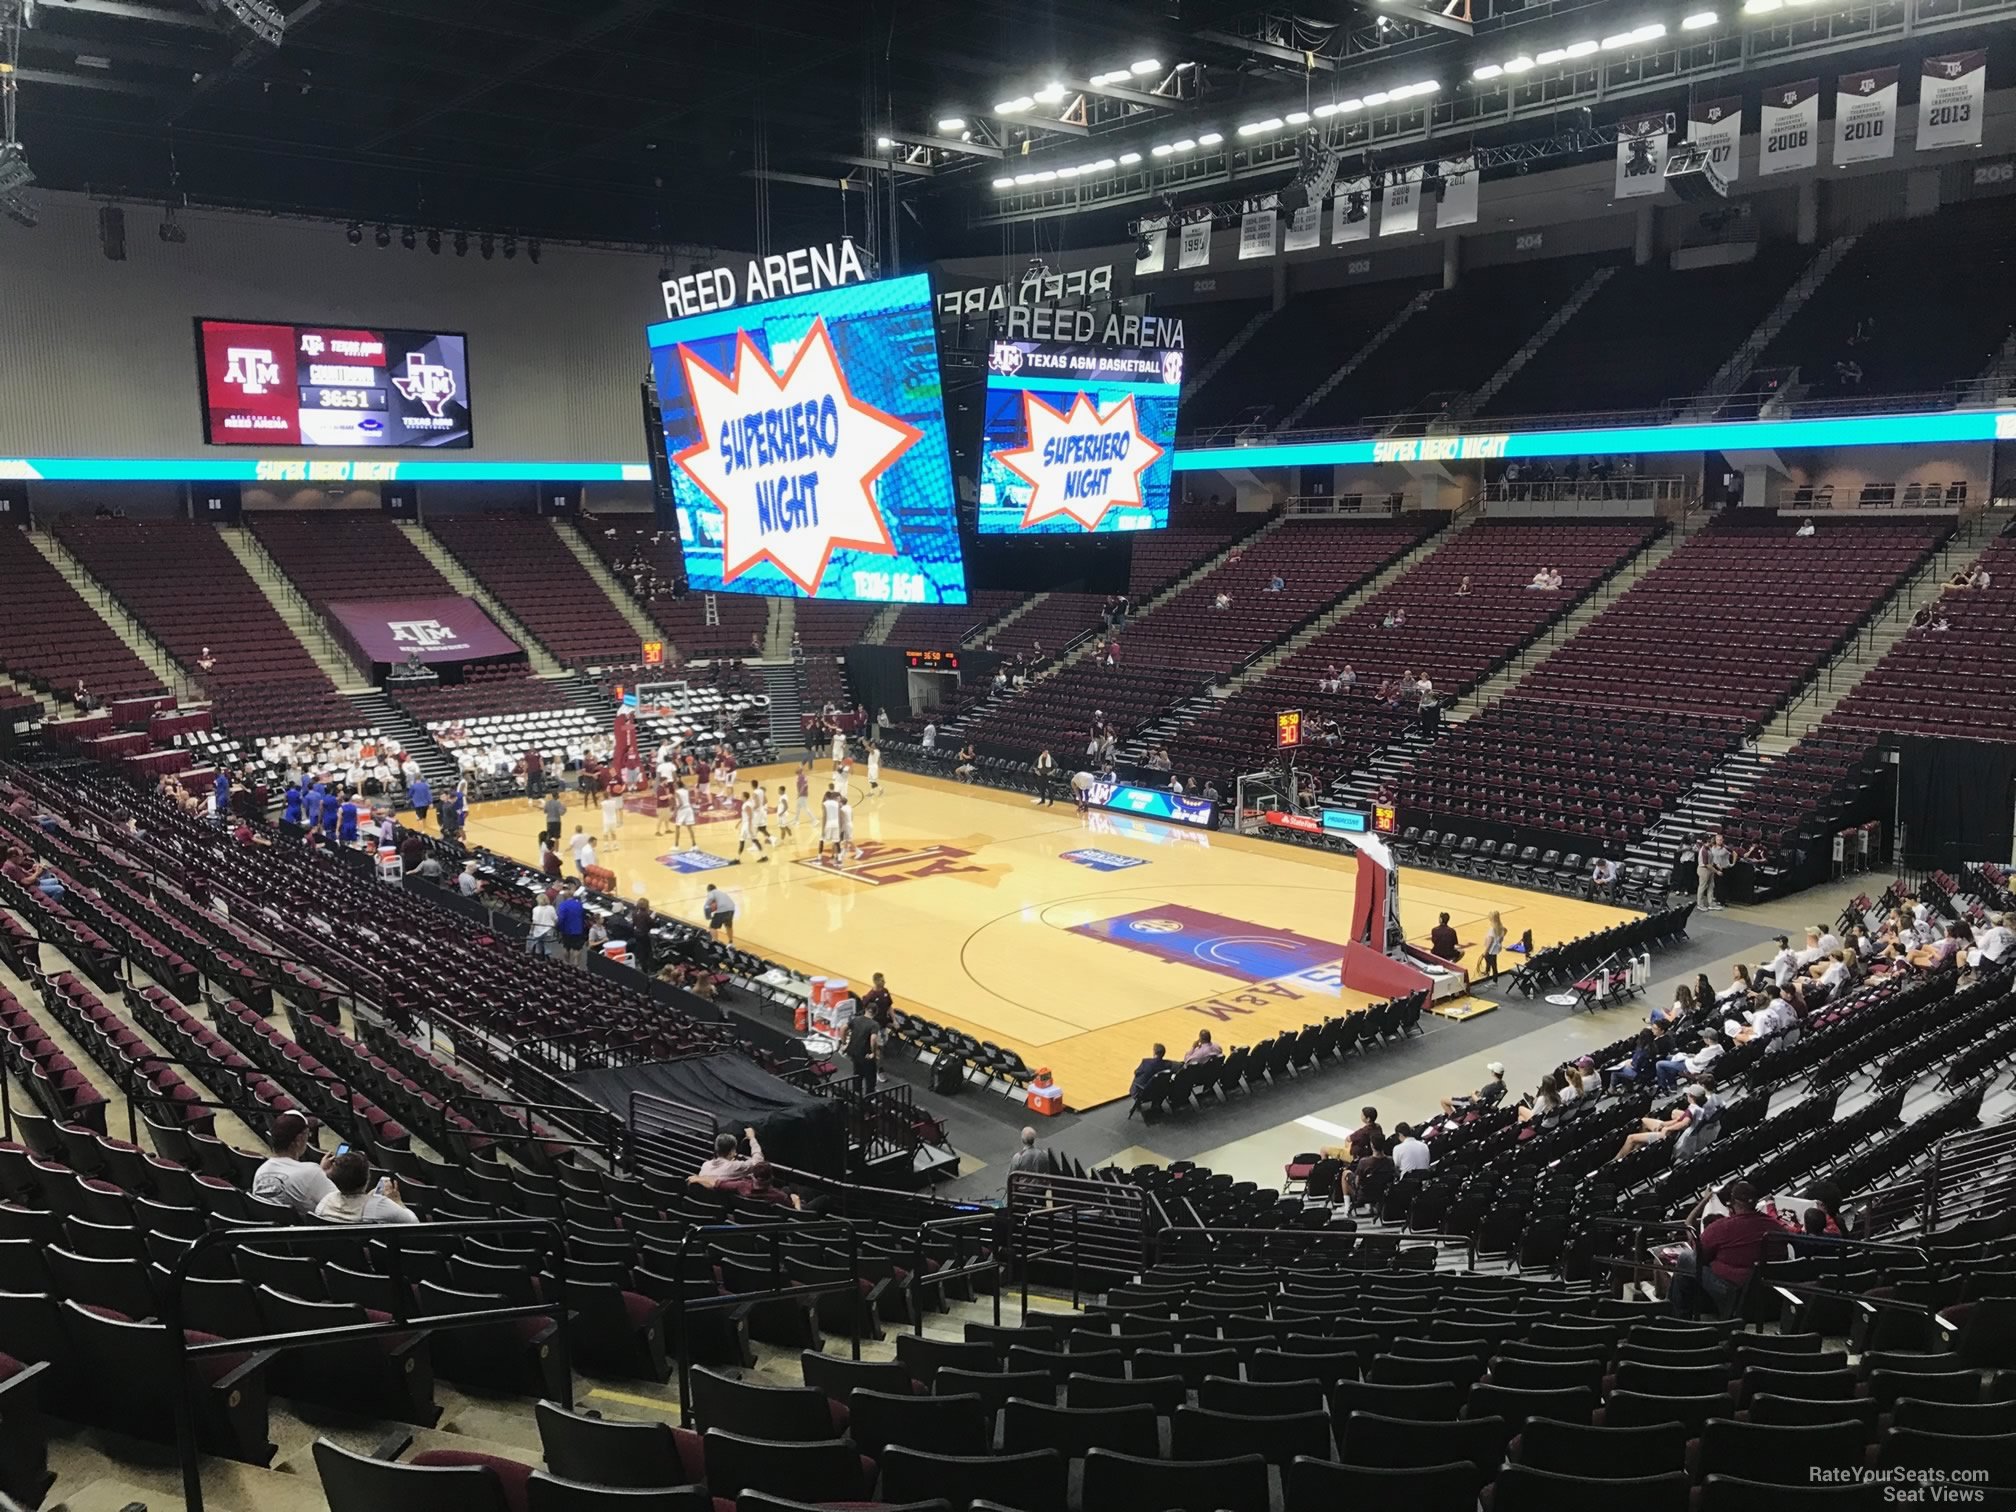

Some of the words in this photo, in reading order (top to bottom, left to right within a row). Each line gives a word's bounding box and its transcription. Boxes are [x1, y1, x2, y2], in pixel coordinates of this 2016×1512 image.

[1929, 104, 1971, 126] 2013
[1845, 120, 1883, 141] 2010
[1768, 130, 1808, 153] 2008
[1450, 175, 1466, 187] 2011
[1974, 164, 2013, 184] 206
[1516, 232, 1543, 249] 204
[1348, 260, 1370, 274] 203
[661, 267, 737, 319] REED
[746, 239, 866, 304] ARENA
[1193, 280, 1216, 292] 202
[1007, 305, 1096, 343] REED
[1102, 313, 1185, 350] ARENA
[1027, 354, 1067, 370] TEXAS
[1069, 355, 1097, 371] A&M
[1099, 358, 1161, 374] BASKETBALL
[320, 389, 369, 408] 36:51
[720, 393, 839, 477] SUPERHERO
[1043, 429, 1131, 468] SUPERHERO
[1373, 441, 1418, 462] SUPER
[1421, 438, 1459, 461] HERO
[1461, 434, 1510, 459] NIGHT
[256, 461, 307, 480] SUPER
[309, 461, 350, 480] HERO
[352, 462, 400, 480] NIGHT
[1064, 466, 1112, 501] NIGHT
[756, 471, 819, 537] NIGHT
[645, 651, 660, 662] 30
[1279, 713, 1299, 727] 36:50
[1281, 725, 1297, 744] 30
[1375, 807, 1394, 820] 36:50
[1378, 818, 1391, 830] 30
